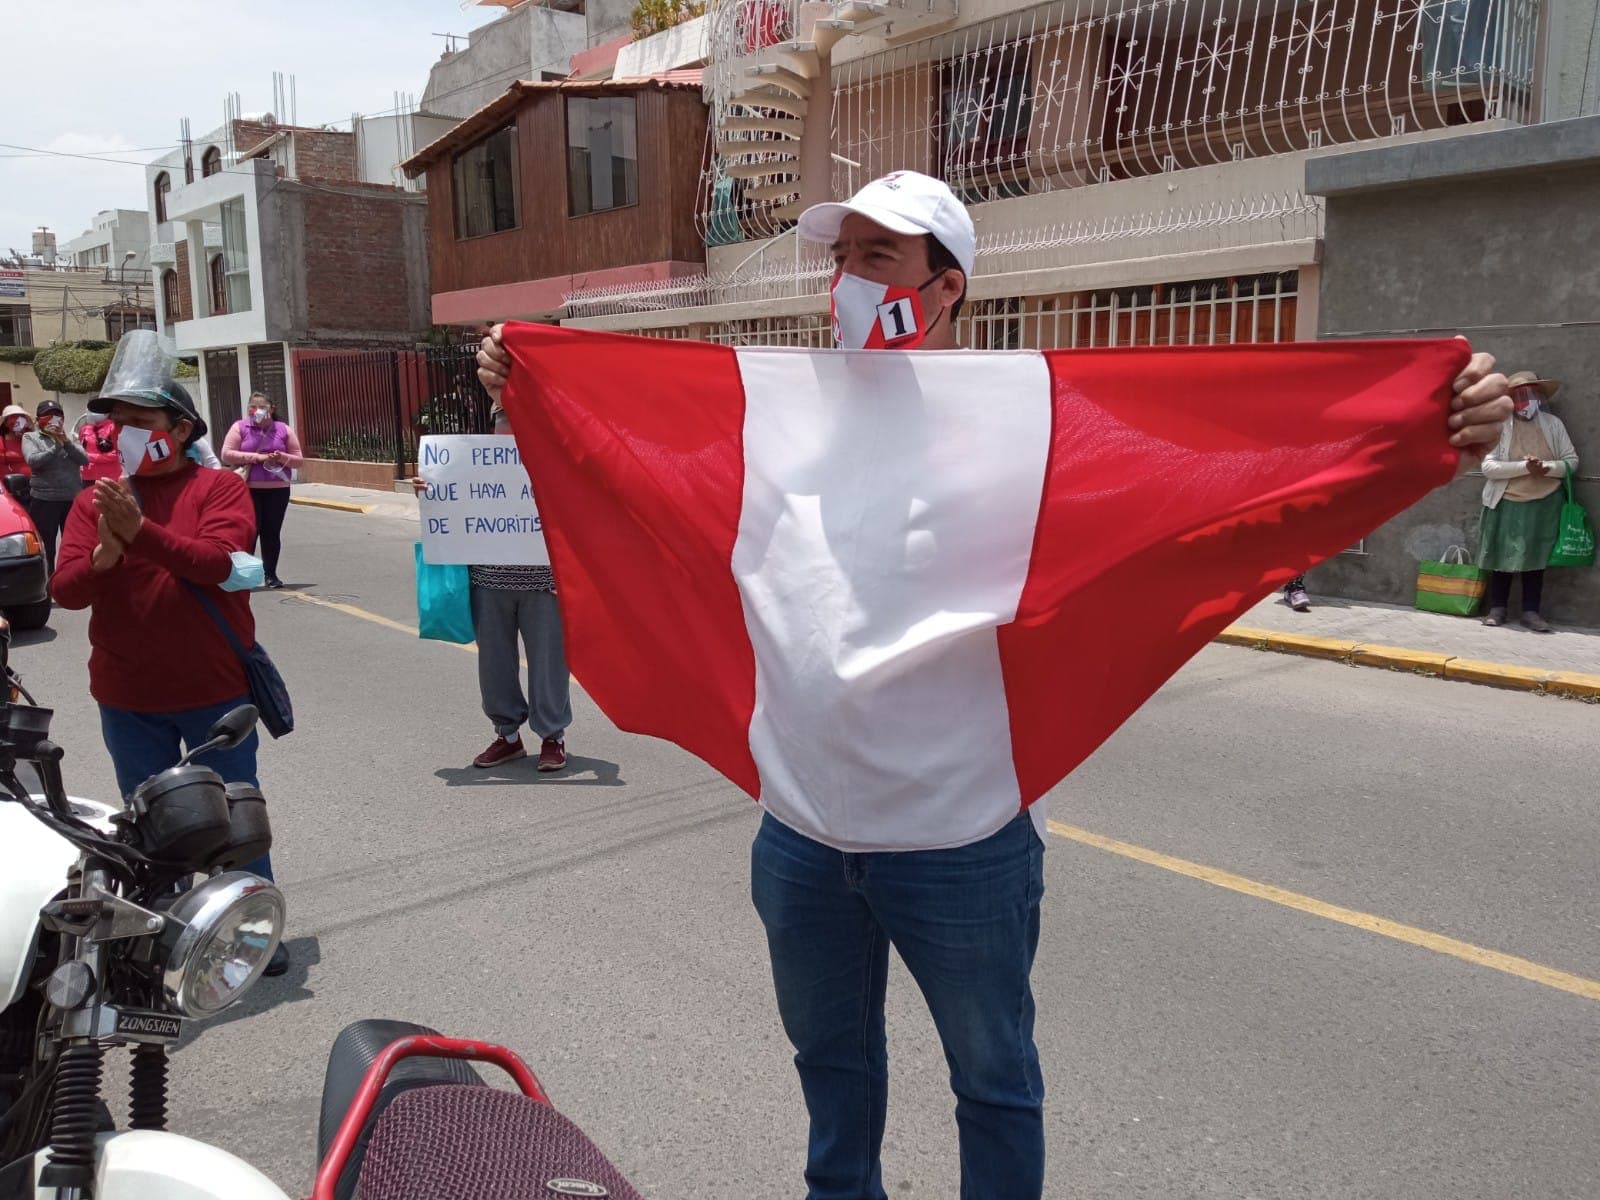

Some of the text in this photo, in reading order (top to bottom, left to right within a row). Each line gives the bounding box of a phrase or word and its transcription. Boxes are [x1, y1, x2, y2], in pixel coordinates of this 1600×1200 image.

[888, 302, 907, 335] 1
[152, 441, 165, 459] 1
[424, 443, 450, 466] NO
[425, 482, 459, 501] QUE
[470, 483, 507, 499] HAYA
[428, 518, 450, 535] DE
[119, 1015, 180, 1034] ZONGSHEN
